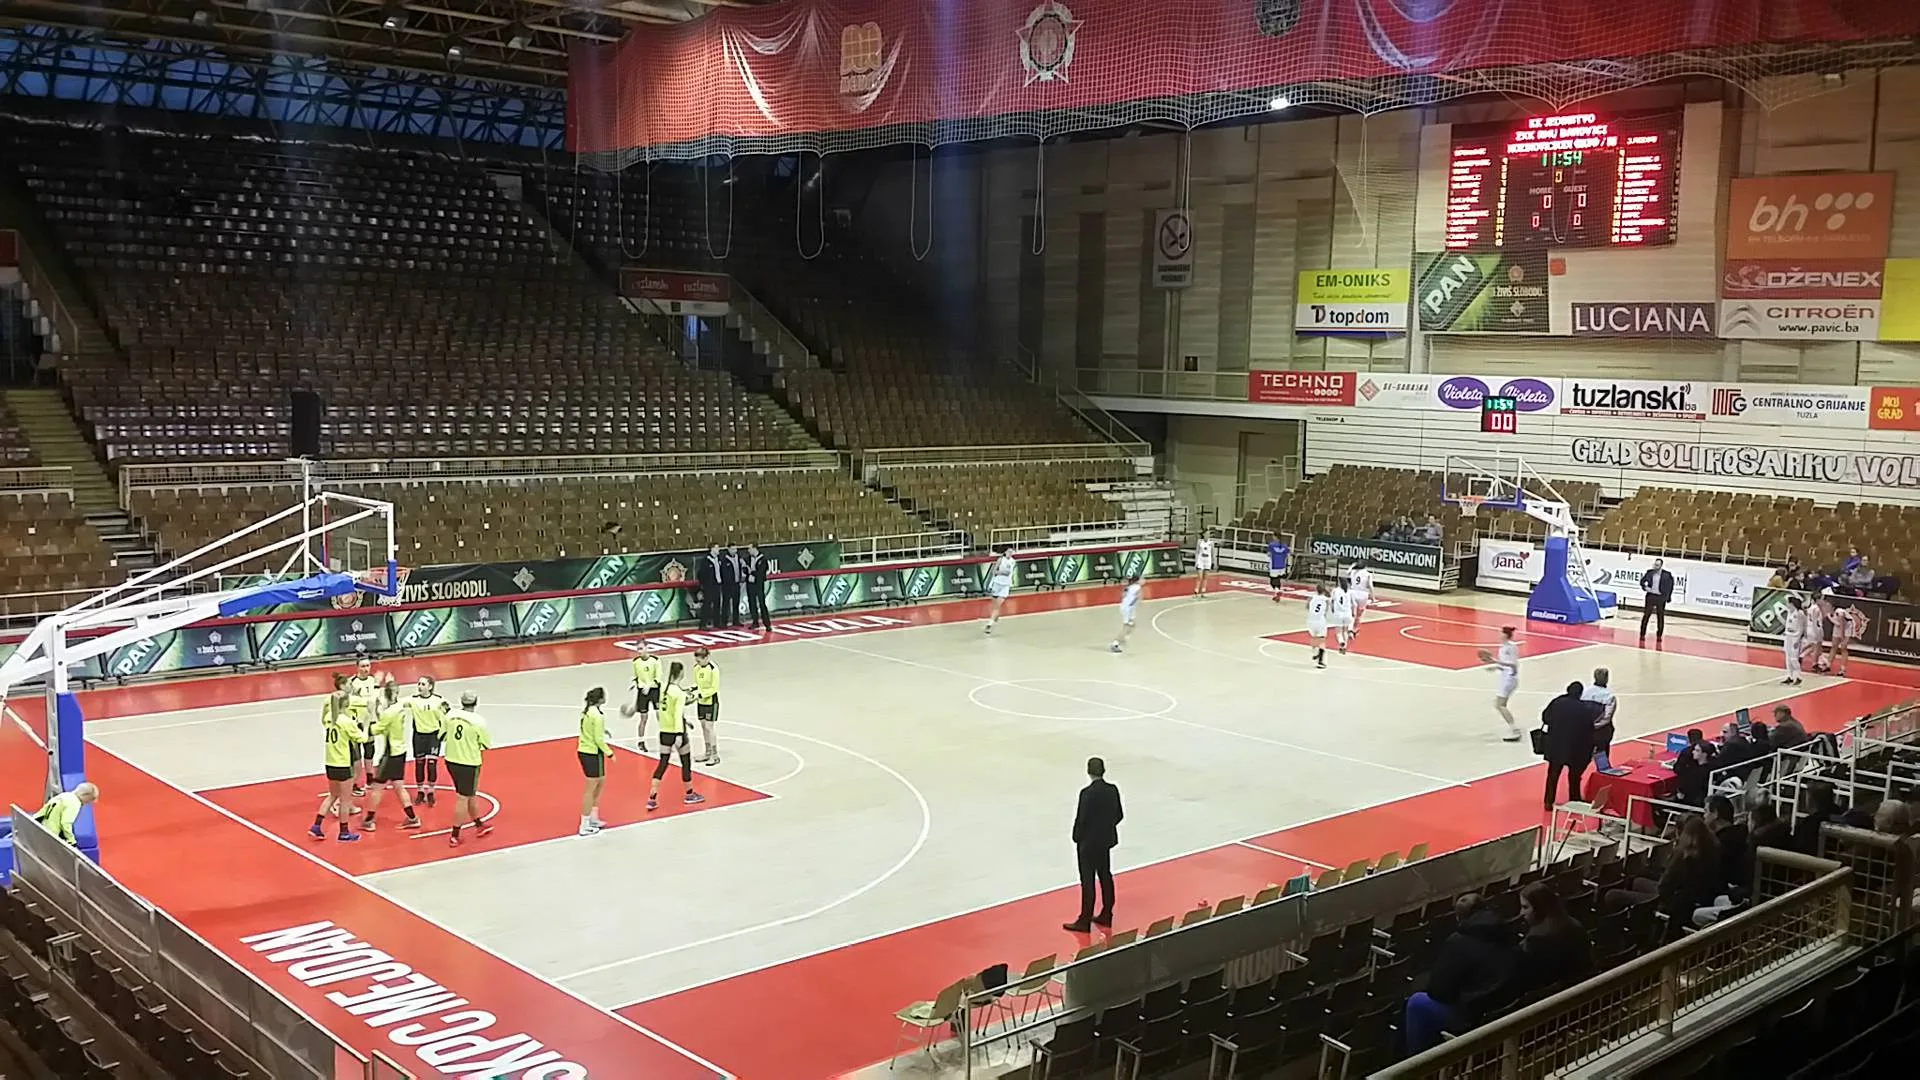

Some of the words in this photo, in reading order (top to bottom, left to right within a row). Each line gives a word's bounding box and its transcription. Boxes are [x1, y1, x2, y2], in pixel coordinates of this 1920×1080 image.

[1541, 150, 1582, 167] 11:54
[1529, 187, 1553, 195] HOME
[1563, 185, 1588, 193] GUEST
[1316, 273, 1391, 288] EM-ONIKS
[1425, 256, 1476, 315] PAN
[1766, 267, 1881, 287] DŽENEX
[1329, 309, 1390, 326] topdom
[1575, 306, 1711, 332] LUCIANA
[1766, 304, 1875, 319] CITROËN
[1778, 322, 1859, 335] www.pavic.ba
[1260, 373, 1343, 388] TECHNO
[1443, 383, 1484, 401] Violeta
[1505, 385, 1549, 403] Violeta
[1573, 383, 1686, 411] tuzlanski
[1487, 399, 1514, 411] 11:54
[1752, 397, 1813, 409] CENTRALNO
[1816, 400, 1866, 412] GRIJANJE
[1491, 413, 1513, 430] 00
[1797, 411, 1818, 419] TUZLA
[1877, 408, 1904, 420] GRAD
[1572, 437, 1634, 467] GRAD
[1638, 439, 1700, 472] SOLI
[1312, 541, 1370, 560] SENSATION!
[1376, 548, 1437, 569] SENSATION!
[911, 570, 931, 598] PAN
[1355, 575, 1361, 585] 9
[432, 578, 491, 602] SLOBODU.
[827, 576, 849, 607] PAN
[636, 591, 662, 626] PAN
[1314, 603, 1322, 613] 5
[528, 602, 556, 636] PAN
[1887, 618, 1900, 638] TI
[408, 610, 437, 648] PAN
[613, 629, 764, 653] GRAD
[760, 614, 913, 638] TUZLA
[273, 623, 304, 661] PAN
[122, 636, 157, 676] PAN
[325, 727, 338, 745] 10
[454, 724, 464, 741] 8
[239, 919, 471, 1029] MEJDAN
